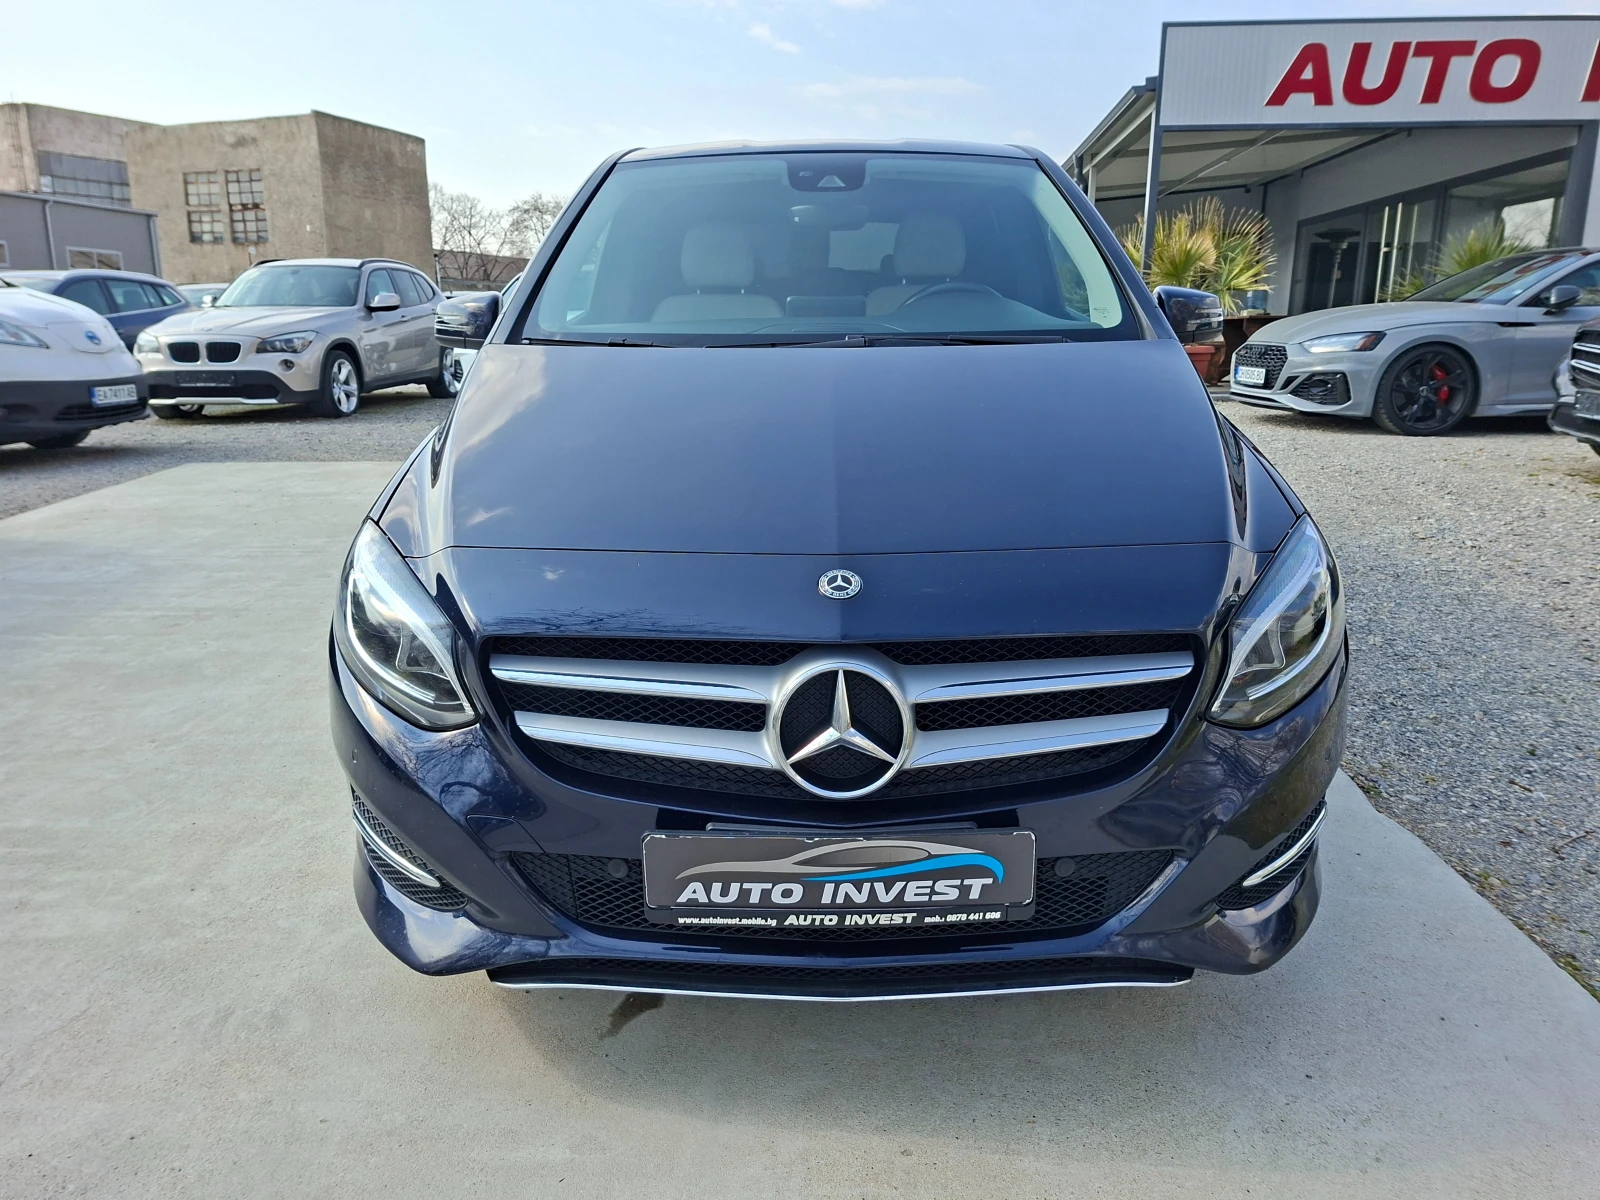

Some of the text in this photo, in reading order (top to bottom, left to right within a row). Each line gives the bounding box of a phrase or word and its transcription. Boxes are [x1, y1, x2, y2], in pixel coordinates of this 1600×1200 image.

[1263, 37, 1542, 107] AUTO
[676, 877, 994, 904] AUTO INVEST
[677, 916, 778, 927] www.autoinvest.mobile.bg
[783, 914, 839, 926] AUTO
[844, 912, 918, 926] INVEST
[968, 912, 983, 921] 441
